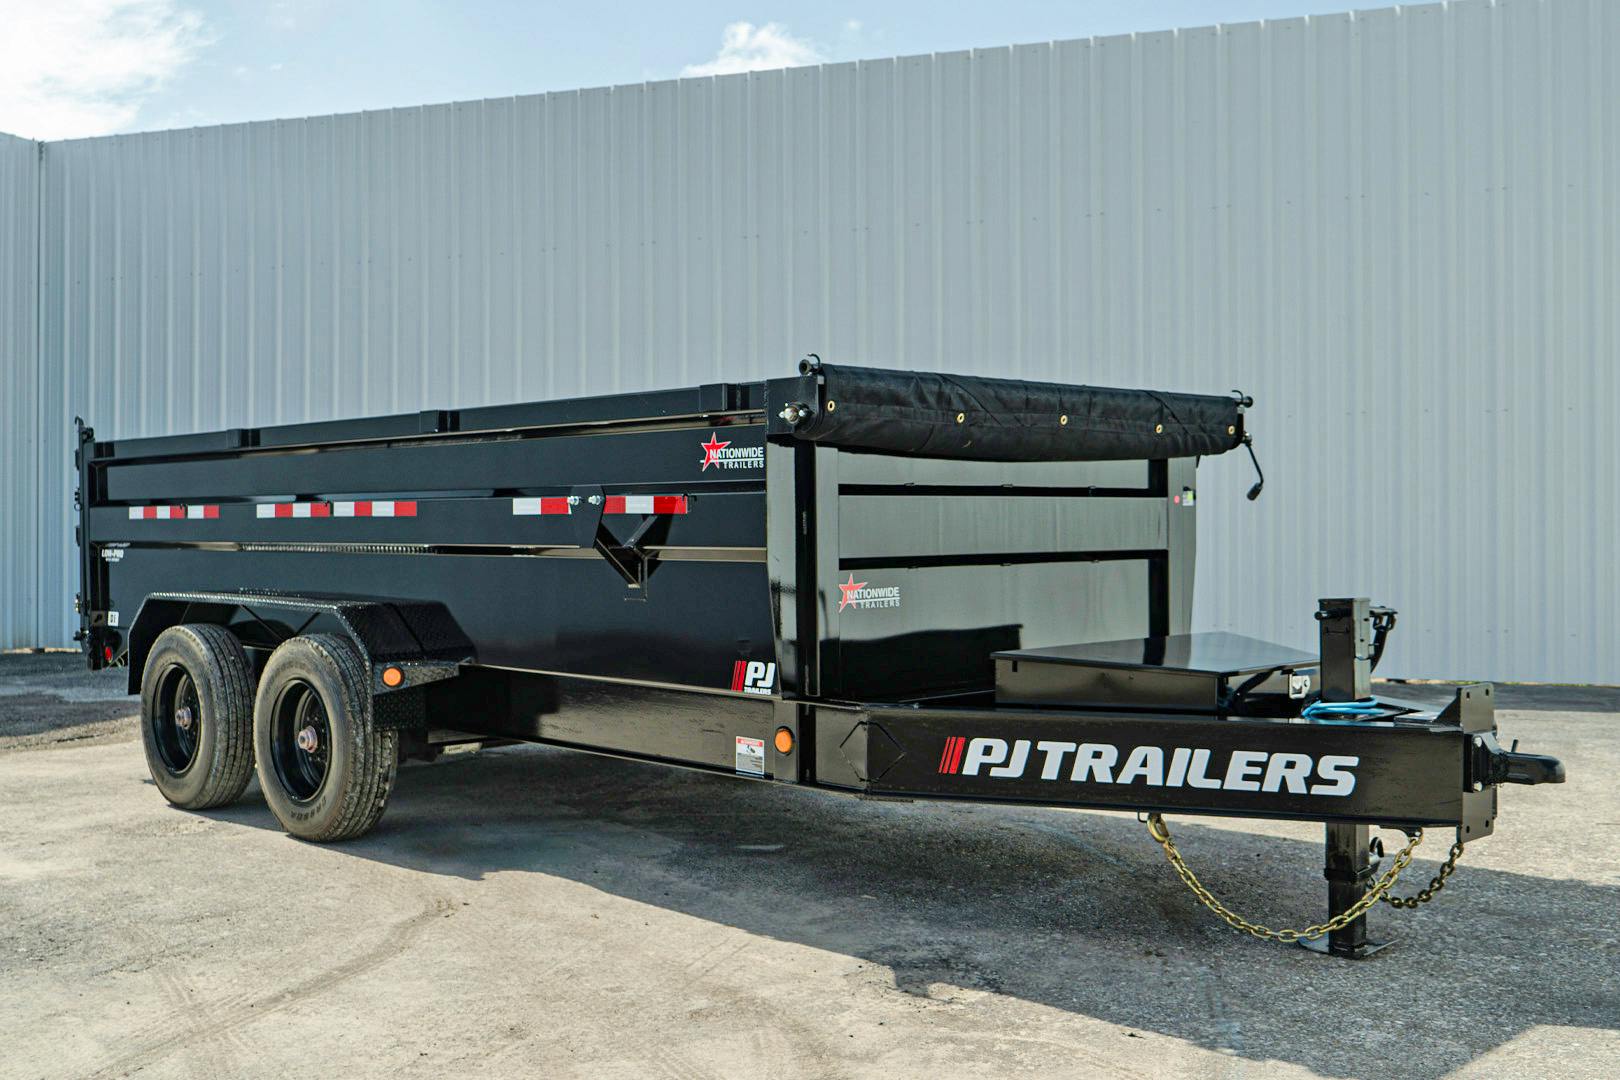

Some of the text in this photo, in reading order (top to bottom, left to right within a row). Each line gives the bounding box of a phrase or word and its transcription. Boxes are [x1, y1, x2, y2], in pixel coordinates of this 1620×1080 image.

[709, 446, 764, 459] NATIONWIDE
[723, 460, 764, 469] TRAILERS
[847, 586, 900, 600] NATIONWIDE
[860, 599, 900, 609] TRAILERS
[744, 660, 776, 688] PJ
[1037, 740, 1360, 797] TRAILERS
